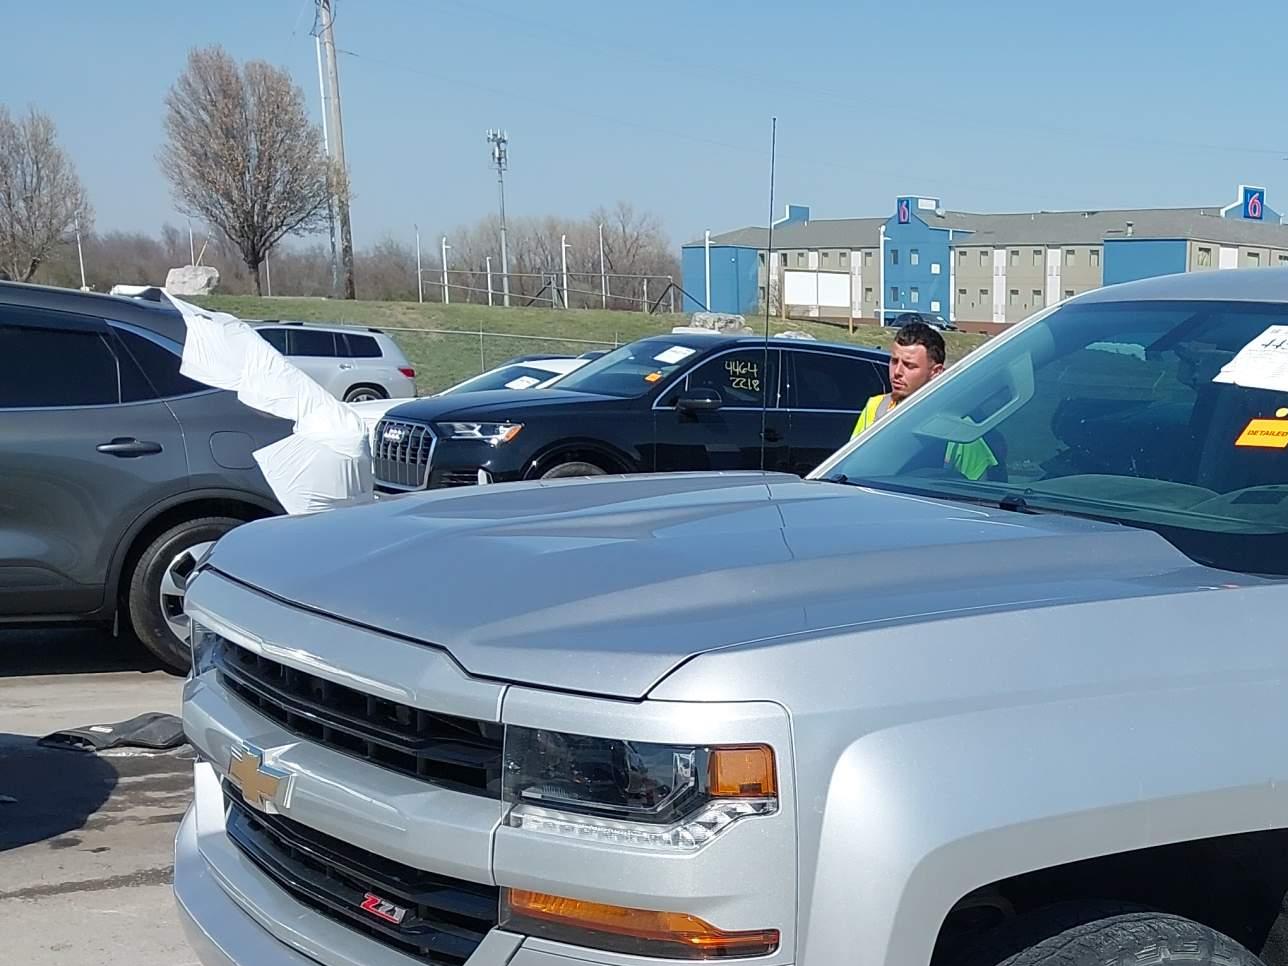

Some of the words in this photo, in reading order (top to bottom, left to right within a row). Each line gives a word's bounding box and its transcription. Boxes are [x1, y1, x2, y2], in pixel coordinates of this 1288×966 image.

[899, 200, 909, 222] 6
[1248, 192, 1262, 218] 6
[725, 360, 758, 378] 4464
[729, 377, 760, 392] 2218
[1247, 429, 1288, 438] DETAILED
[360, 891, 406, 924] Z71
